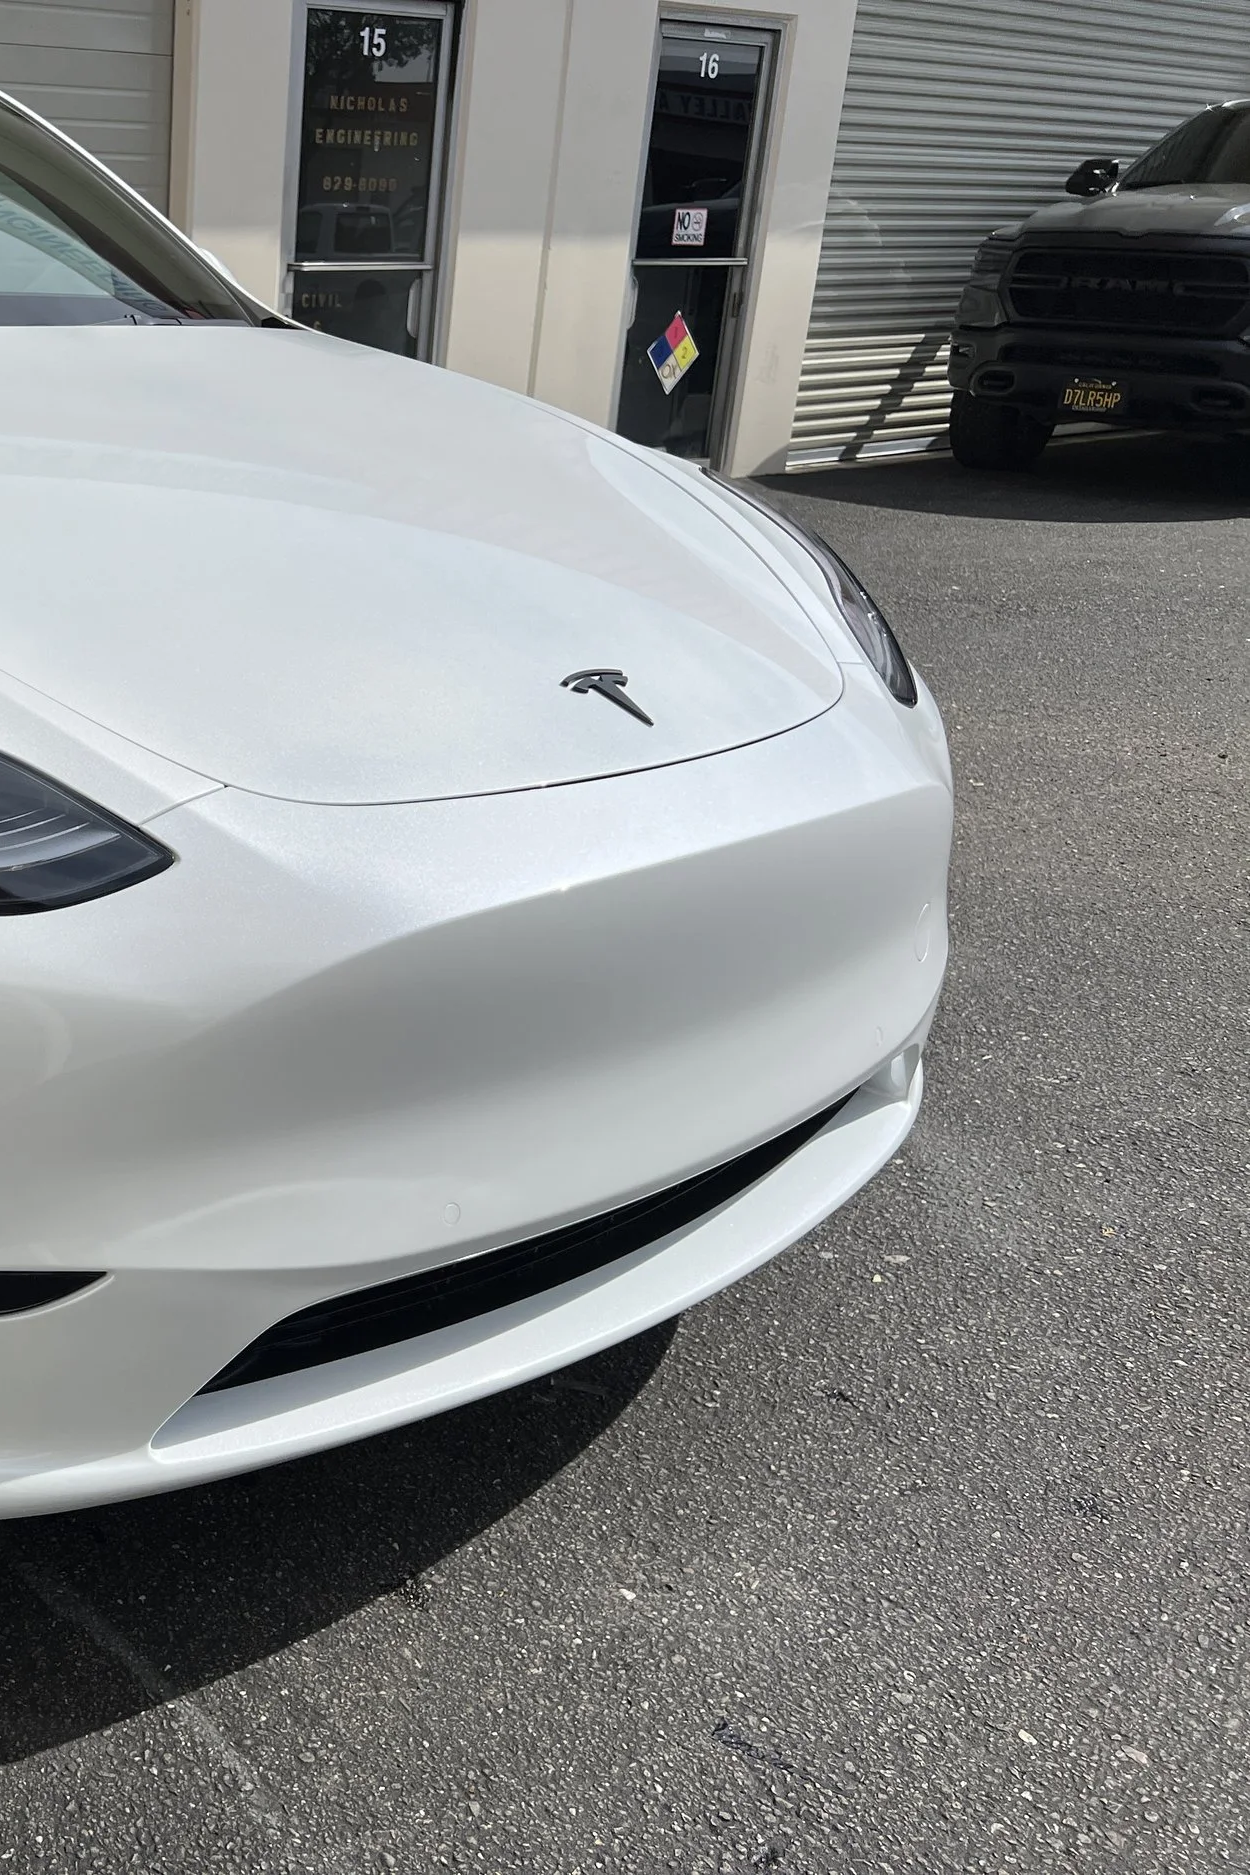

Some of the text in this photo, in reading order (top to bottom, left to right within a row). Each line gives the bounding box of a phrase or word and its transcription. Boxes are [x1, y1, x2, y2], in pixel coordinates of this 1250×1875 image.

[359, 26, 387, 57] 15
[699, 52, 720, 79] 16
[329, 95, 408, 112] NICHOLAS
[315, 128, 419, 146] ENGINEERING
[676, 211, 691, 230] NO
[301, 293, 343, 308] CIVIL
[1063, 388, 1121, 409] D7LR5HP
